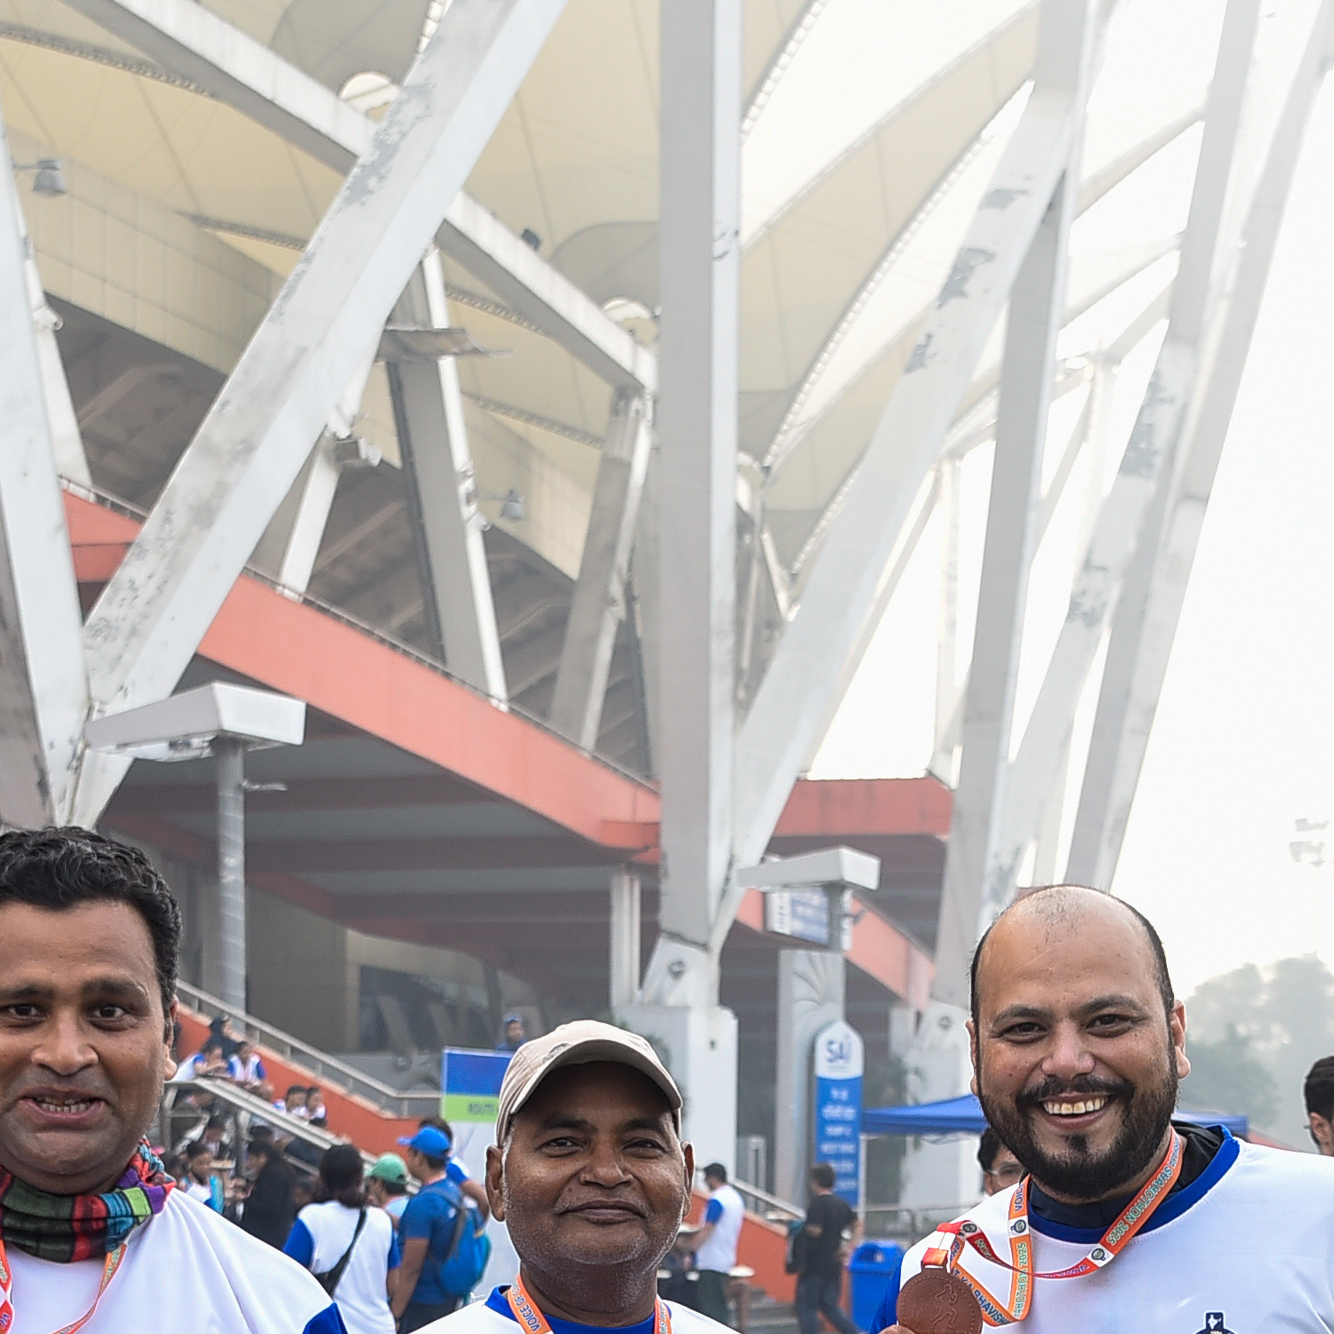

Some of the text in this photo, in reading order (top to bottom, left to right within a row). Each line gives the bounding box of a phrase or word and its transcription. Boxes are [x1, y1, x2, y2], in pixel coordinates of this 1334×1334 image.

[1014, 1183, 1025, 1212] VOIC
[1107, 1222, 1129, 1247] 2025
[1017, 1242, 1027, 1267] 2025
[520, 1304, 542, 1332] VOICE
[973, 1288, 1011, 1326] BHAVISH
